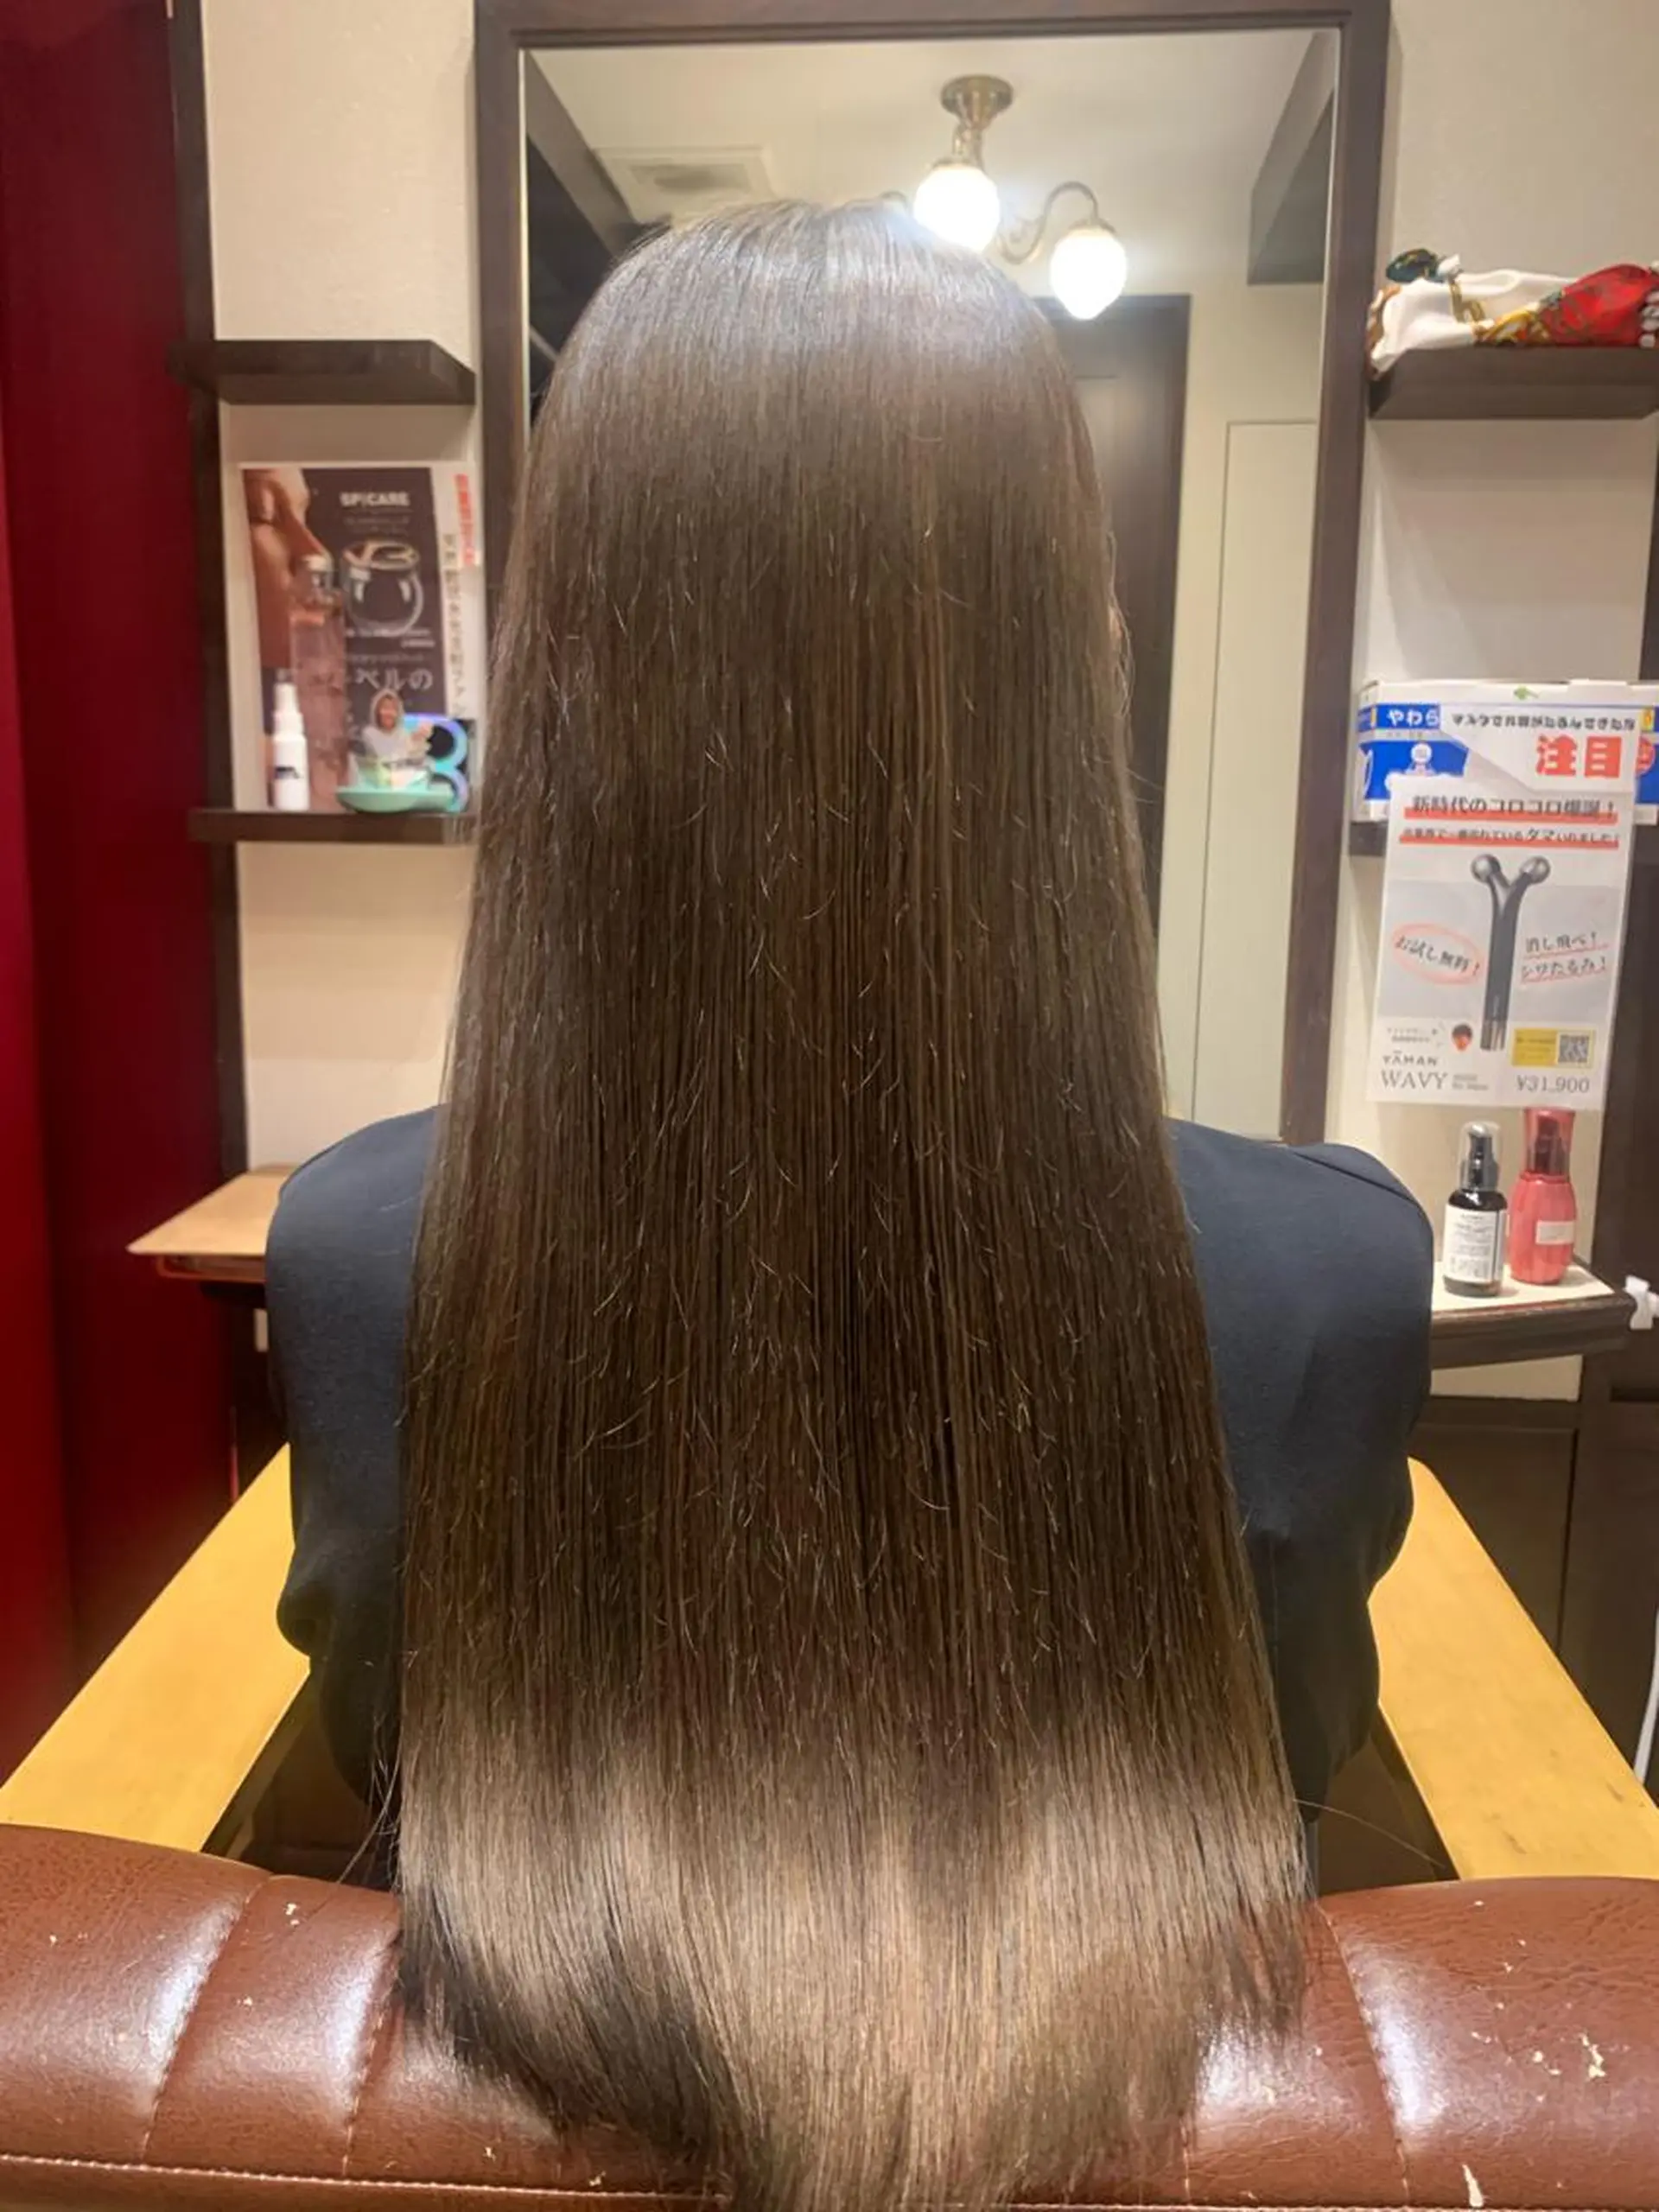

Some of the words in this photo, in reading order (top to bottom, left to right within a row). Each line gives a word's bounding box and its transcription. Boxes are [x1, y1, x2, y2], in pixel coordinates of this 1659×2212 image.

[1386, 709, 1439, 727] やわら
[1535, 734, 1623, 778] 注目
[1381, 1068, 1449, 1090] WAVY
